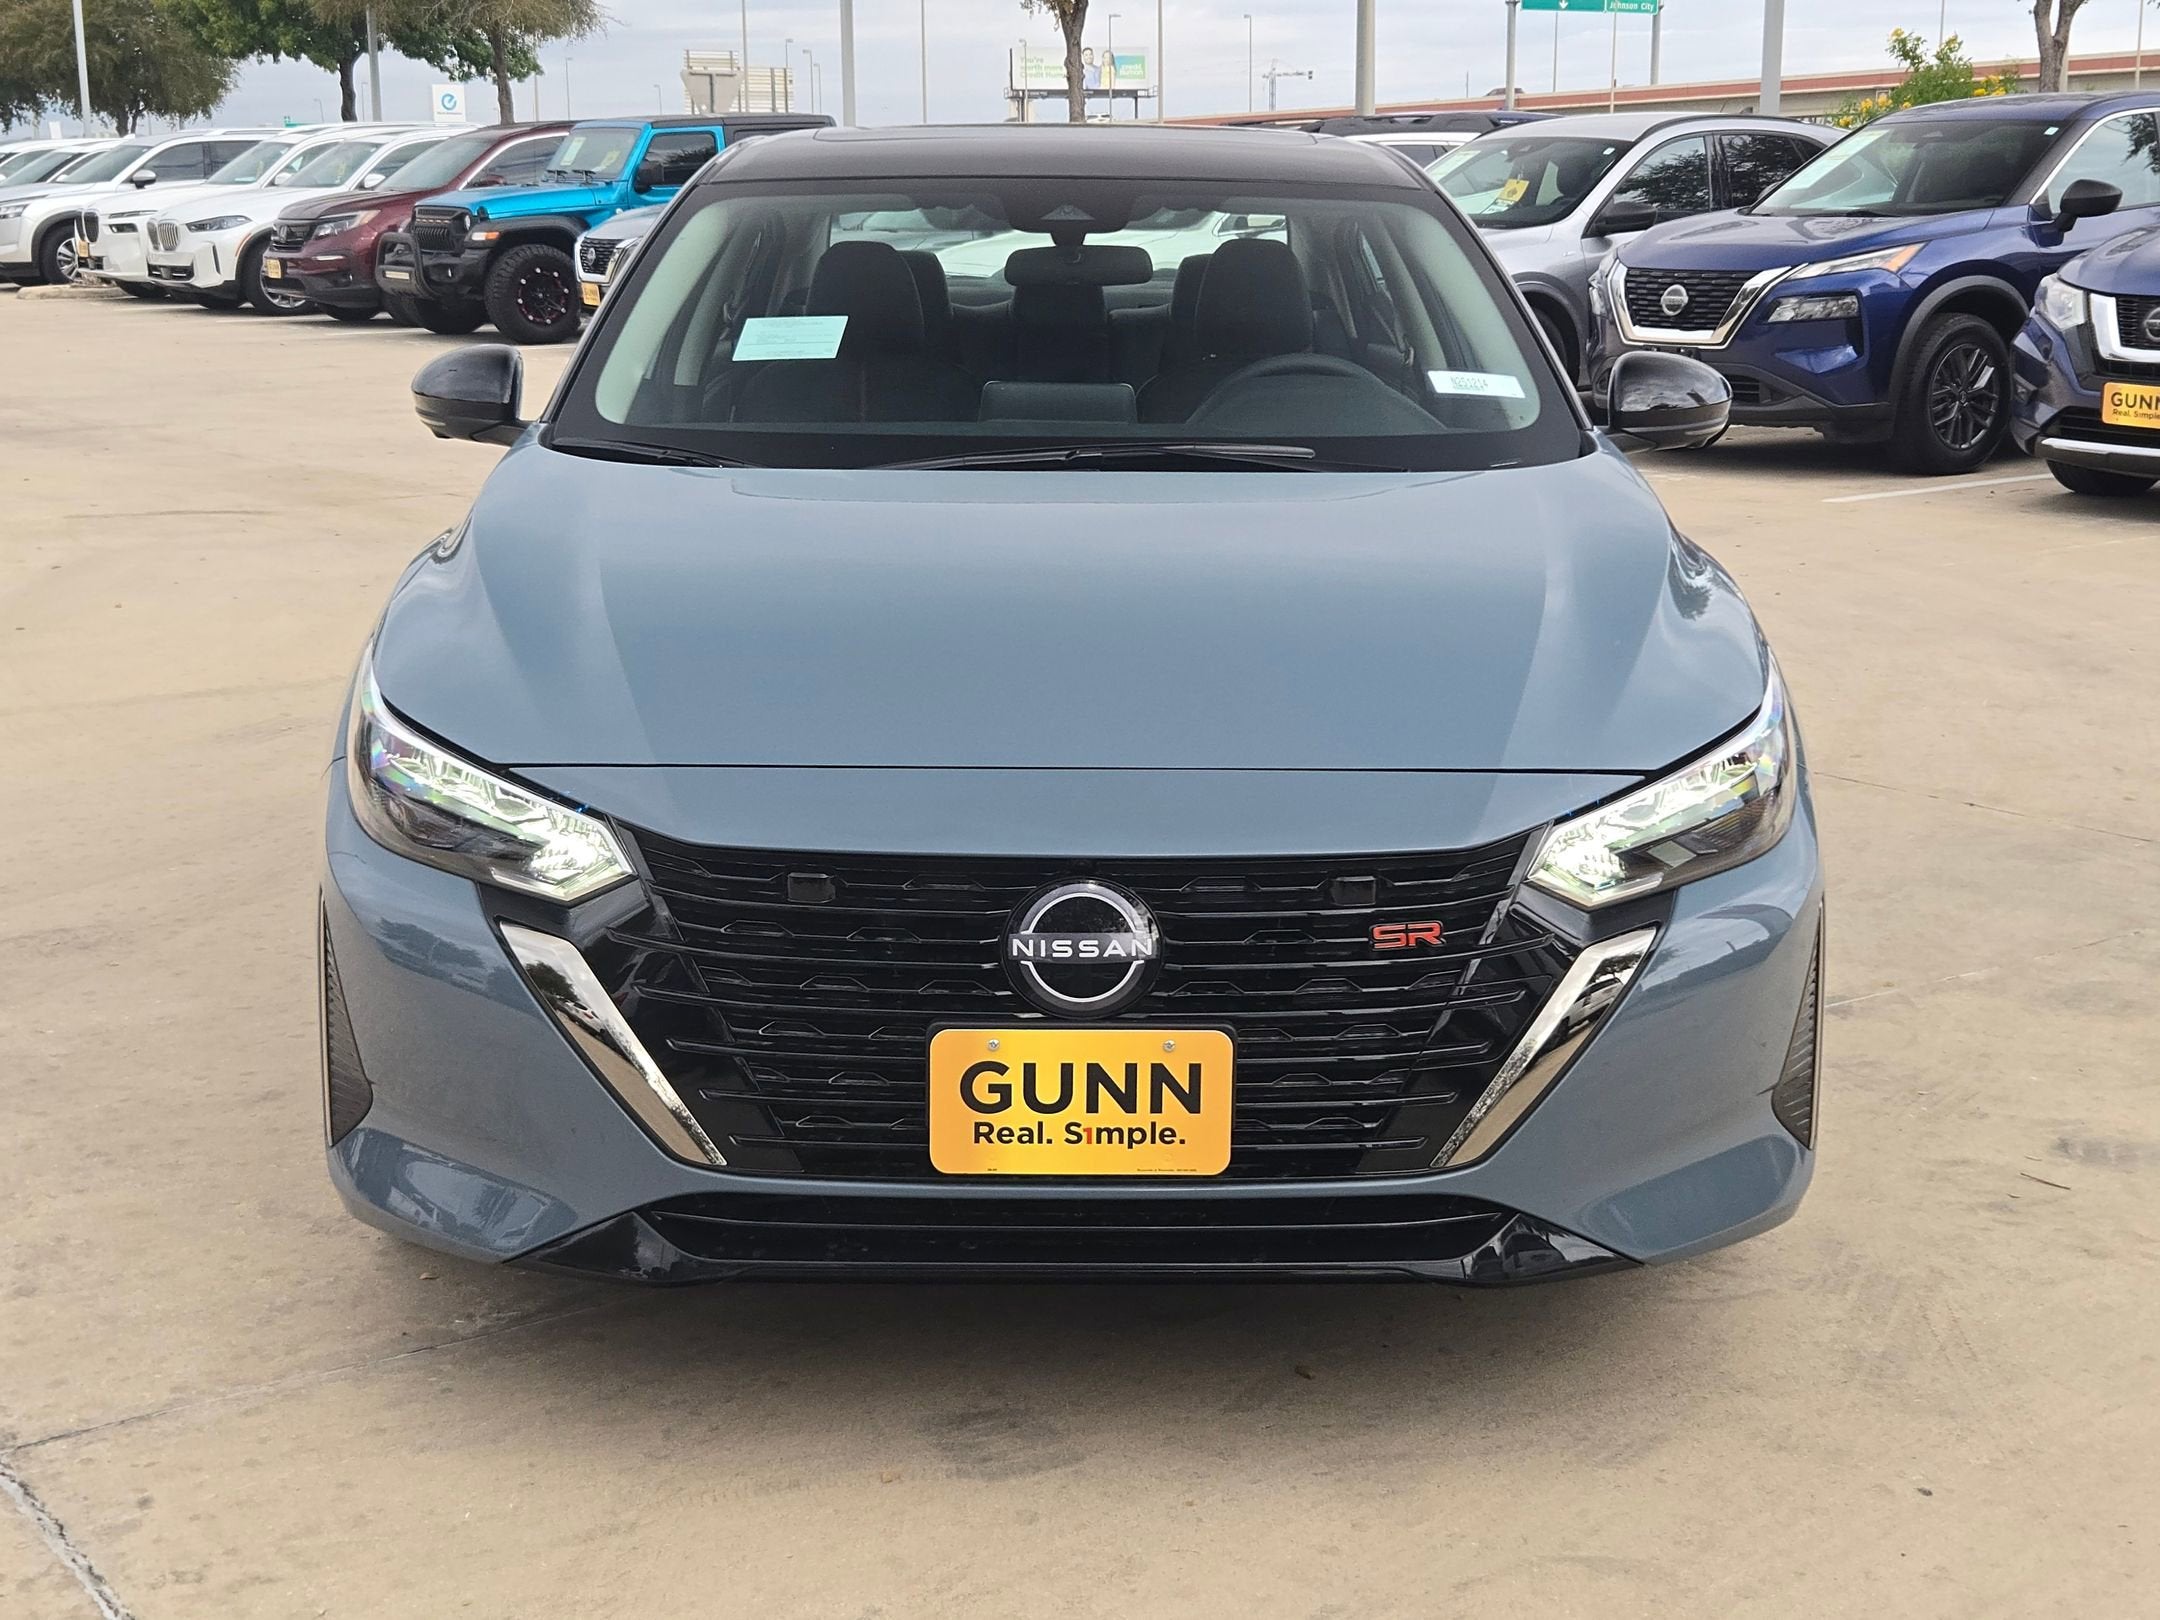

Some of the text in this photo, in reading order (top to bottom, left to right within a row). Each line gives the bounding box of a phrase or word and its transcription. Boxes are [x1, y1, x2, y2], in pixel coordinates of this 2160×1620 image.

[1641, 2, 1655, 12] City
[1370, 920, 1445, 950] SR
[1012, 938, 1153, 958] NISSAN
[959, 1060, 1202, 1115] GUNN
[973, 1121, 1053, 1145] Real.
